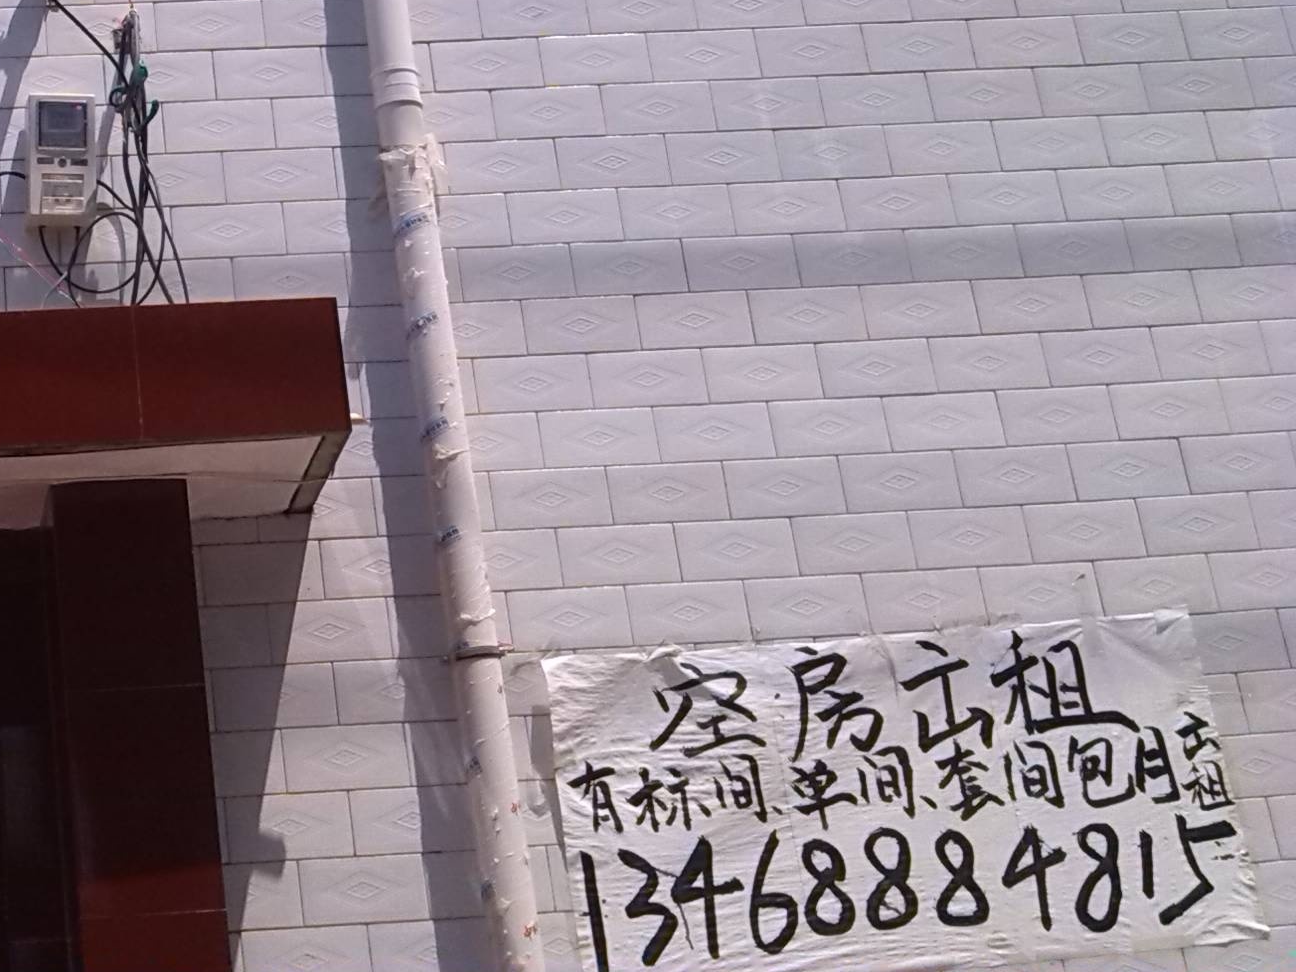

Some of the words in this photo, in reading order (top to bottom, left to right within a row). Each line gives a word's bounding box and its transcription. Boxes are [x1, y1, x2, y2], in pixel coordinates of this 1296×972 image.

[649, 630, 1139, 763] 空房出租
[580, 814, 1239, 972] 13468884815
